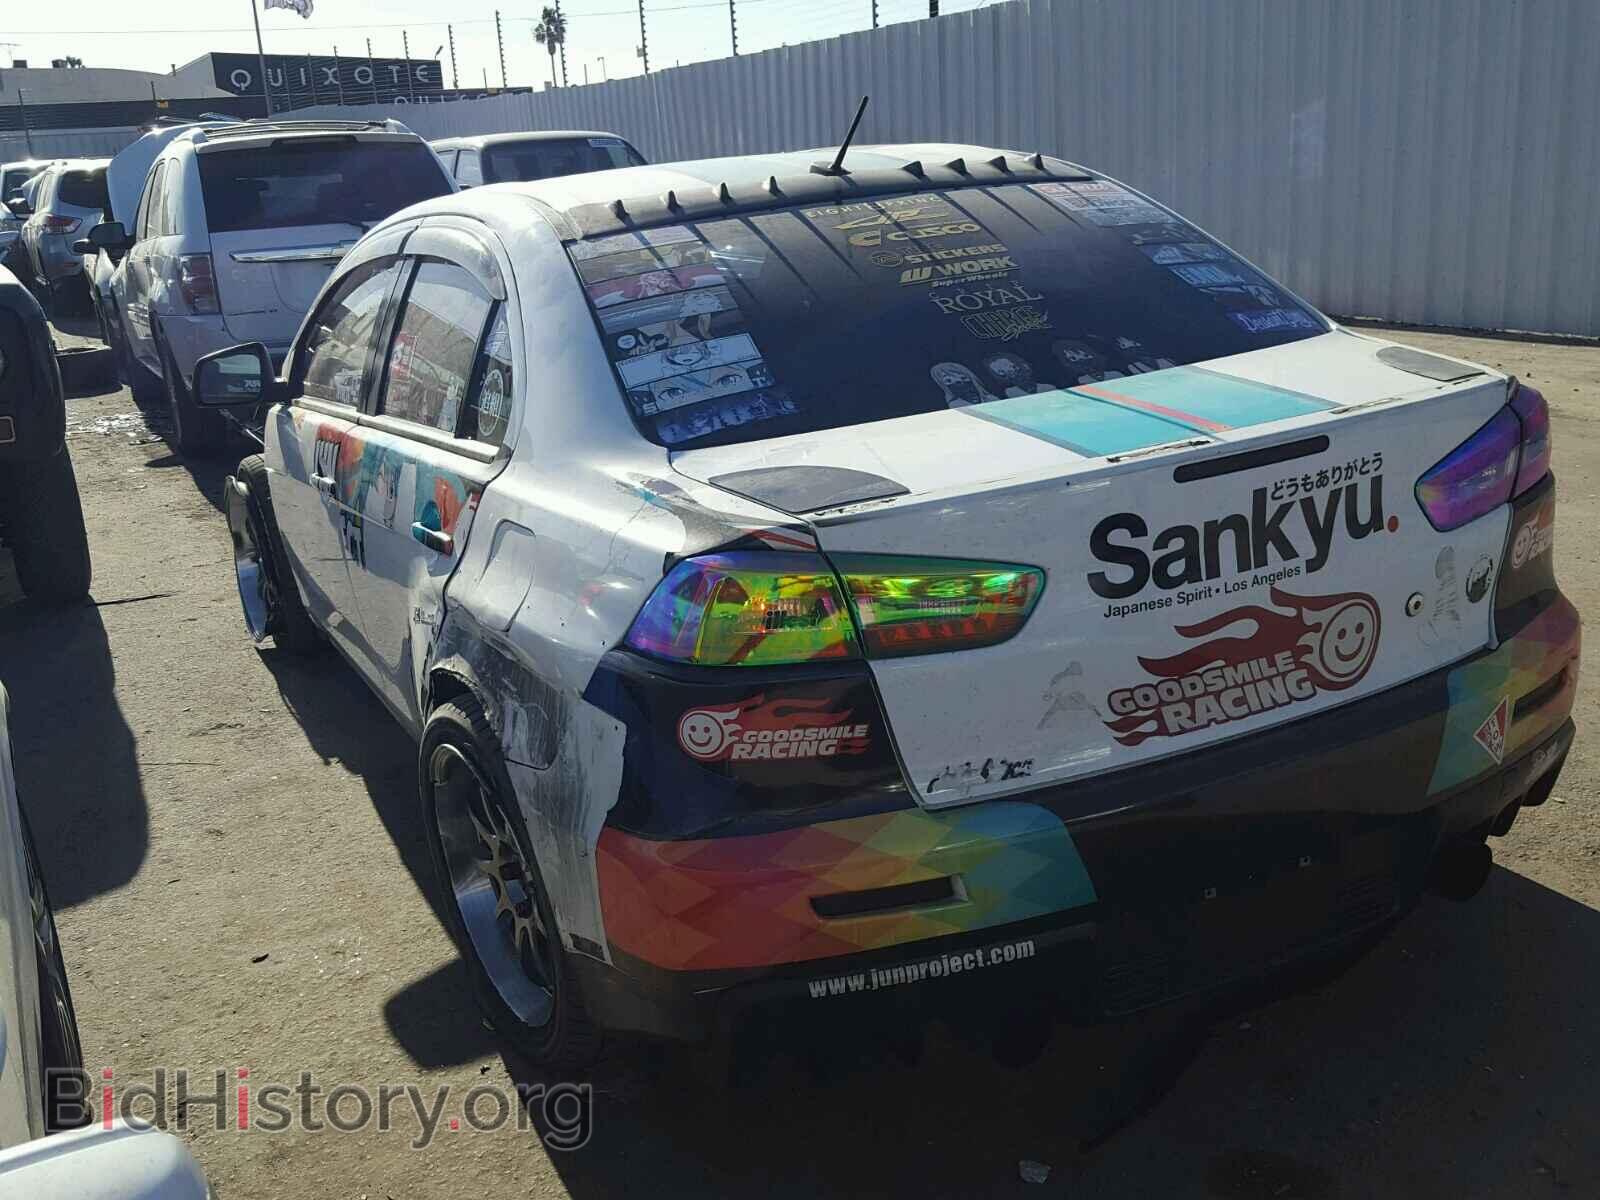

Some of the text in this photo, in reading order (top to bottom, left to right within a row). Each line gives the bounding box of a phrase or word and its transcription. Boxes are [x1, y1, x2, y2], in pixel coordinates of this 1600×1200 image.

[230, 64, 430, 91] QUIXOTE
[886, 222, 982, 241] CUSCO
[903, 243, 1009, 264] STICKERS
[934, 256, 1019, 276] WORK
[928, 285, 1045, 314] ROYAL
[1270, 452, 1383, 501] どうもありがとう
[1087, 474, 1399, 599] Sankyu.
[1103, 565, 1302, 619] Japanese Spirit Los Angeles
[1108, 651, 1297, 715] GOODSMILE
[1160, 668, 1317, 736] RACING
[742, 724, 869, 743] GOODSMILE
[730, 739, 839, 760] RACING
[808, 939, 1036, 998] www.junproject.com
